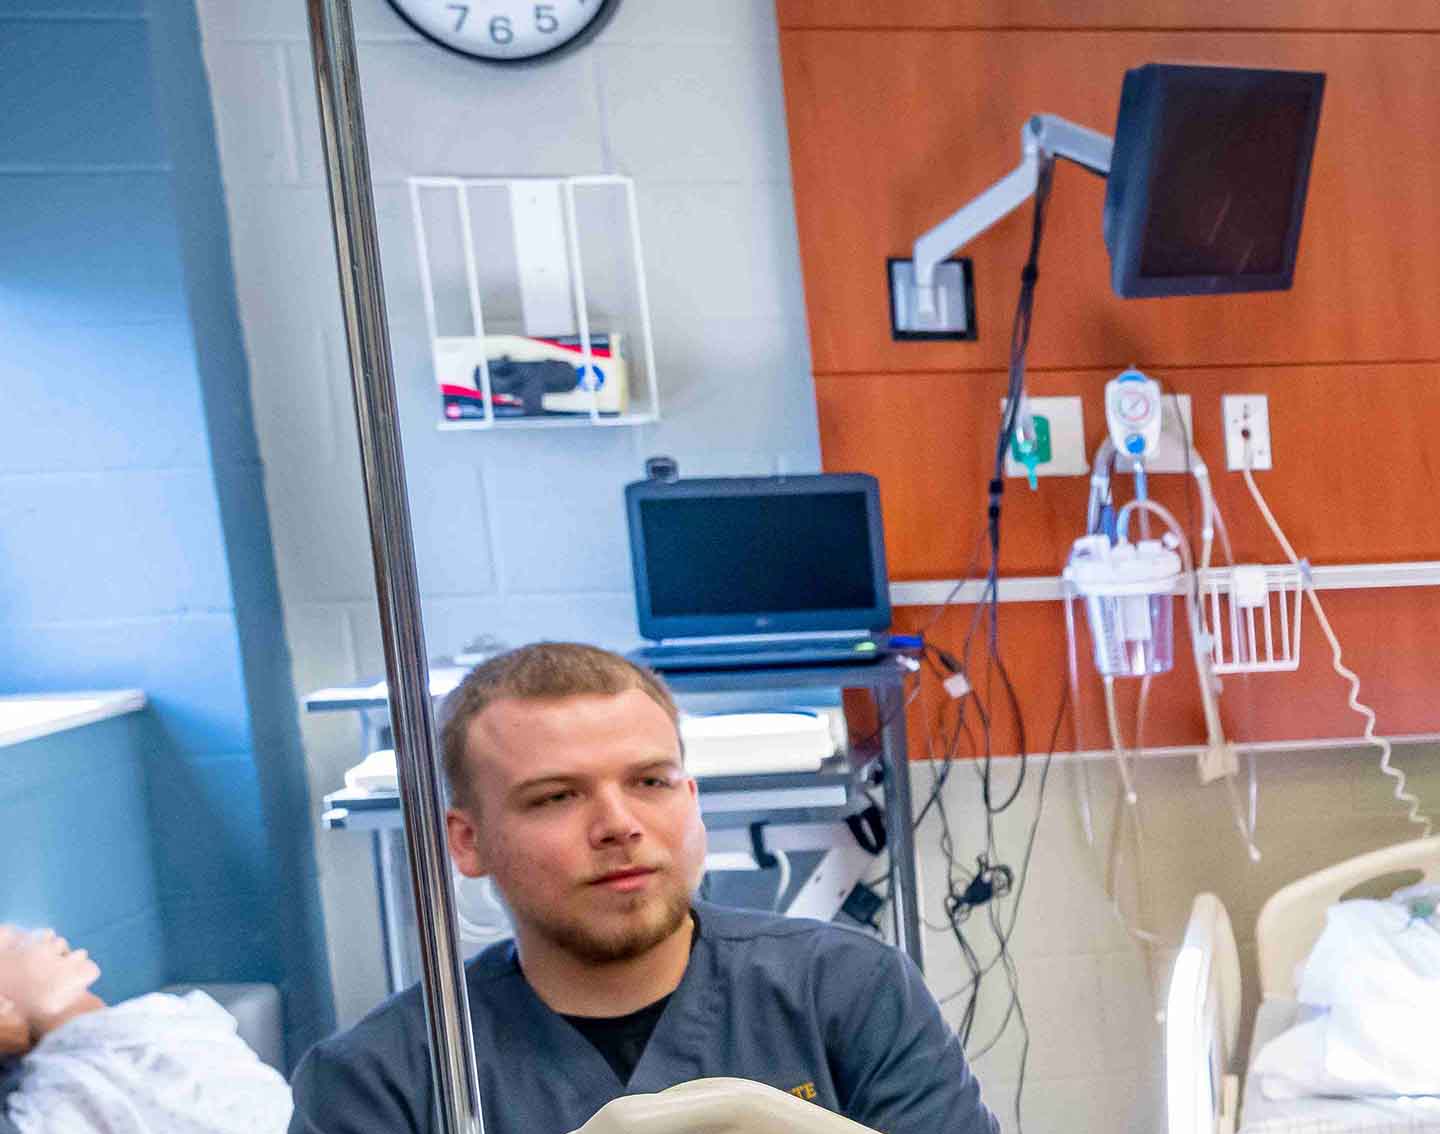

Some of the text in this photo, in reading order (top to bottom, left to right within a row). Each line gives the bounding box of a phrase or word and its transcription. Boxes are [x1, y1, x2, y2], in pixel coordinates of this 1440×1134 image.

[446, 4, 469, 32] 7
[488, 15, 514, 44] 6
[534, 4, 559, 34] 5
